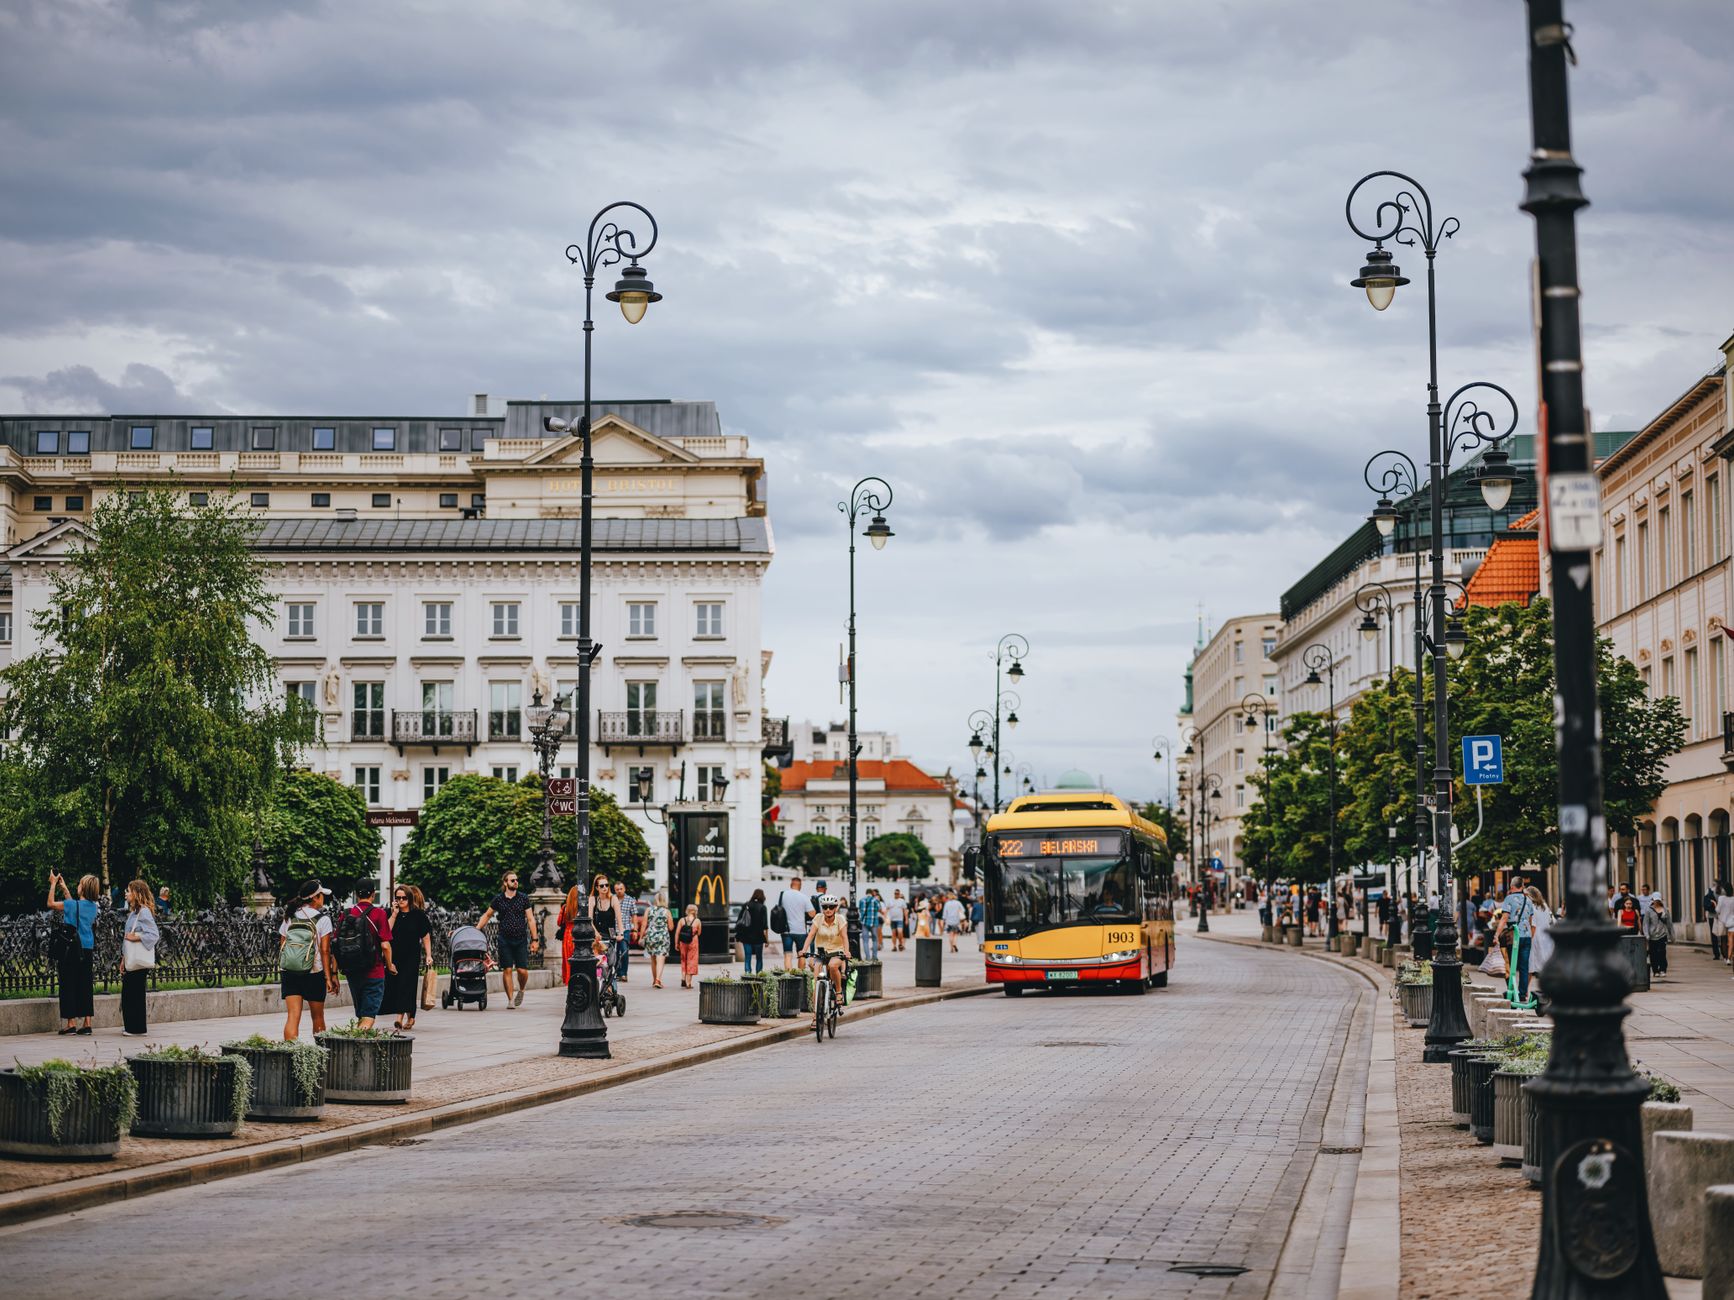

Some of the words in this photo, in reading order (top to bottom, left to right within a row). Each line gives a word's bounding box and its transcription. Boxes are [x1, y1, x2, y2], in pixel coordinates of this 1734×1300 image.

[549, 479, 600, 491] HOTL
[1471, 740, 1494, 770] P
[559, 801, 574, 812] WC
[697, 845, 716, 854] 800
[998, 839, 1024, 856] 222
[1107, 931, 1135, 944] 1903
